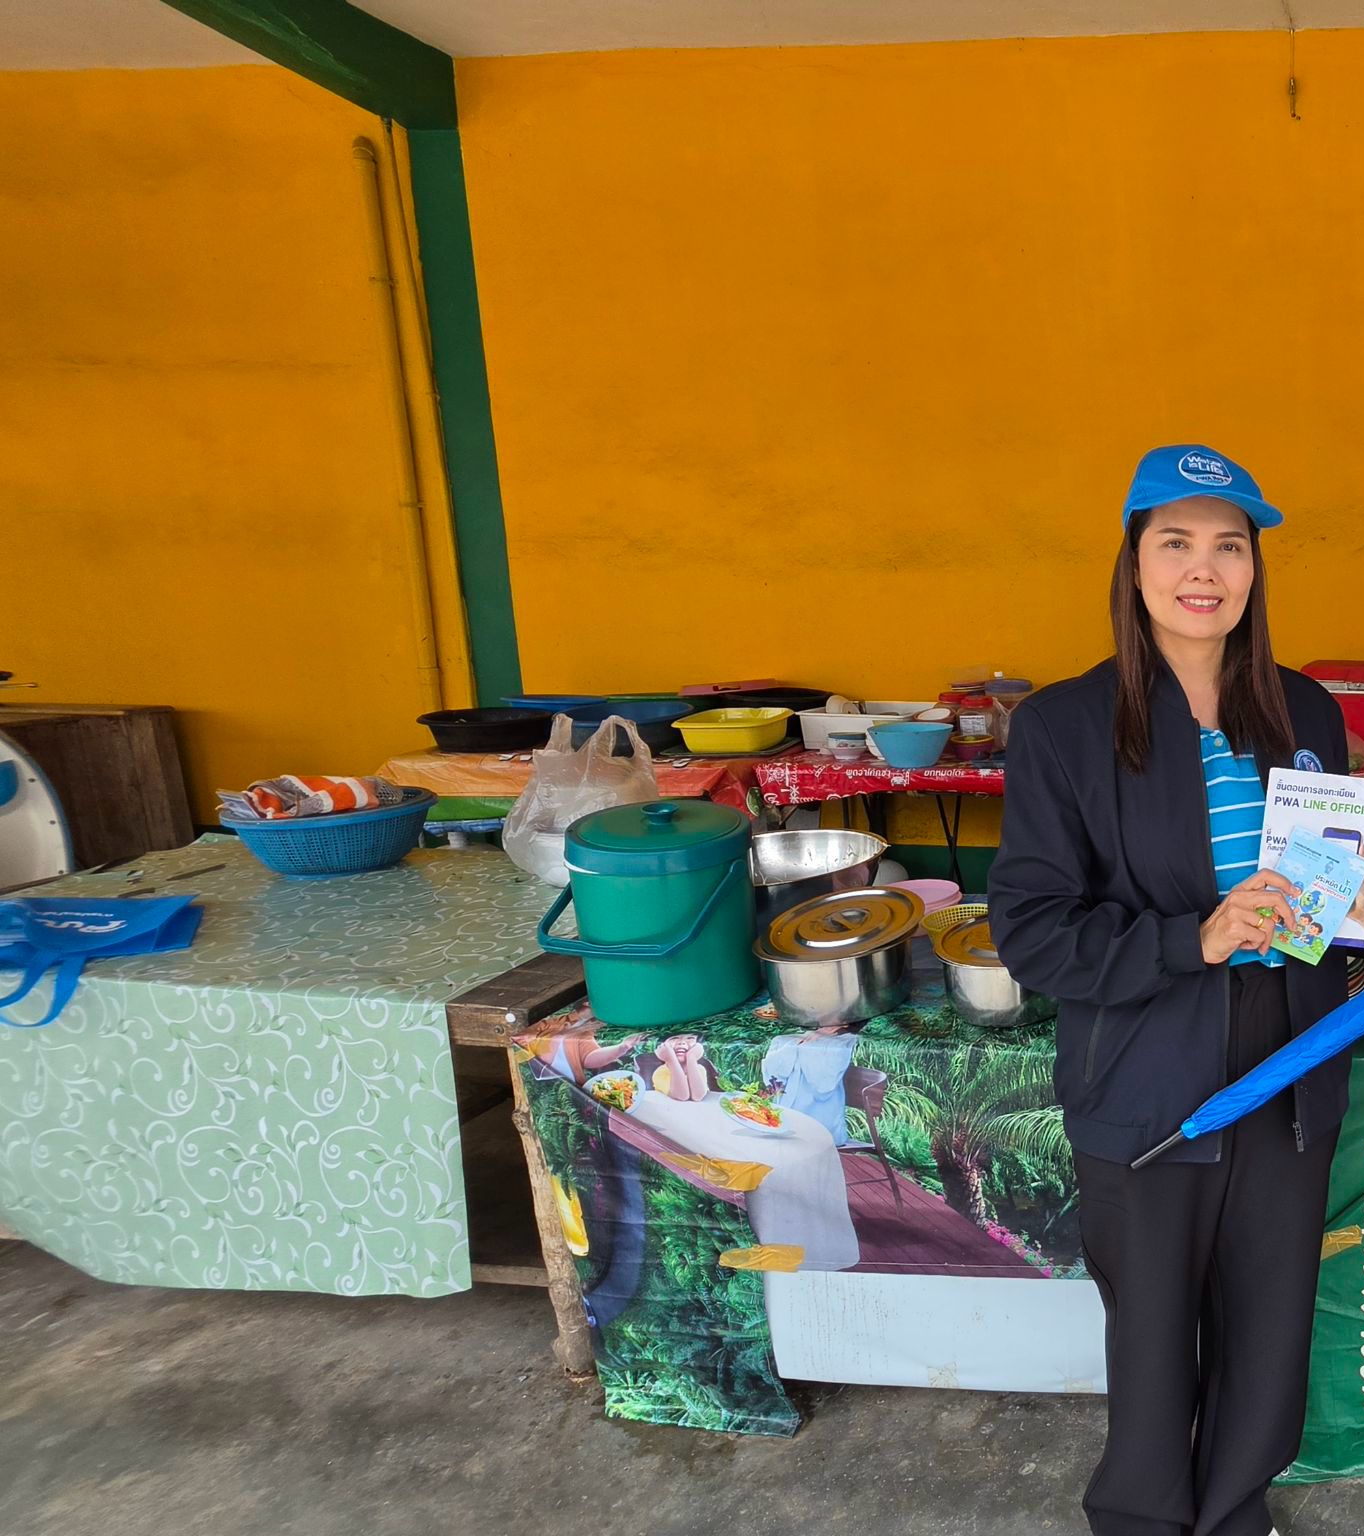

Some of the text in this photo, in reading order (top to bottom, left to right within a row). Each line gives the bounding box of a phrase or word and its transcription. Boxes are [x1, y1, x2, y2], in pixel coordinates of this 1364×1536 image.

[1276, 779, 1356, 799] ขั้นตอนการลงทะเบียน
[1273, 796, 1300, 808] PWA
[1303, 799, 1327, 811] LINE
[1265, 836, 1288, 846] PWA
